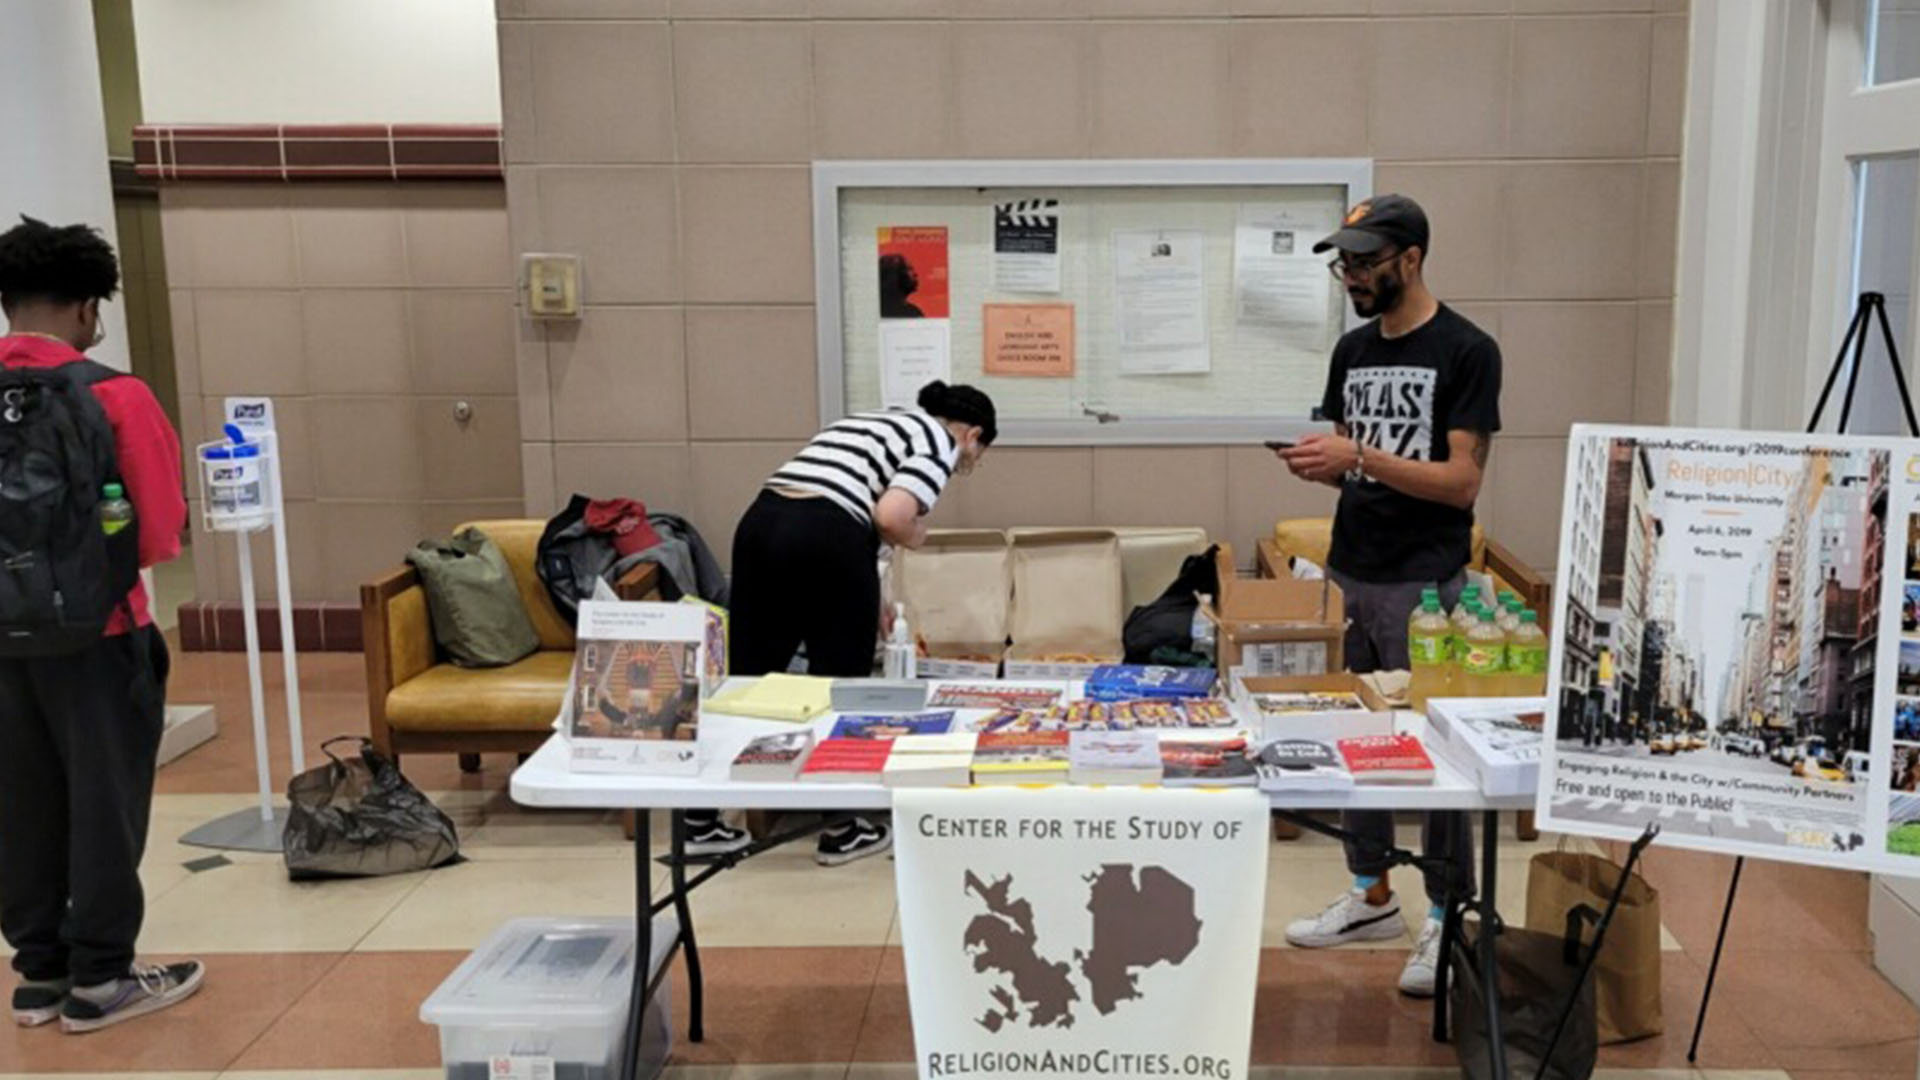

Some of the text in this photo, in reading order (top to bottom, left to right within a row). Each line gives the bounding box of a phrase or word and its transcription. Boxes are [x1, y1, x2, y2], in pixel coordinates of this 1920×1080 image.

[1346, 380, 1424, 419] MAS
[1688, 524, 1713, 536] April
[1727, 526, 1752, 537] 2019
[1556, 778, 1734, 812] Free and open to the Public!
[1558, 759, 1855, 802] Engaging Religion & the City w/Community Partners
[918, 813, 1242, 840] CENTER FOR THE STUDY OF
